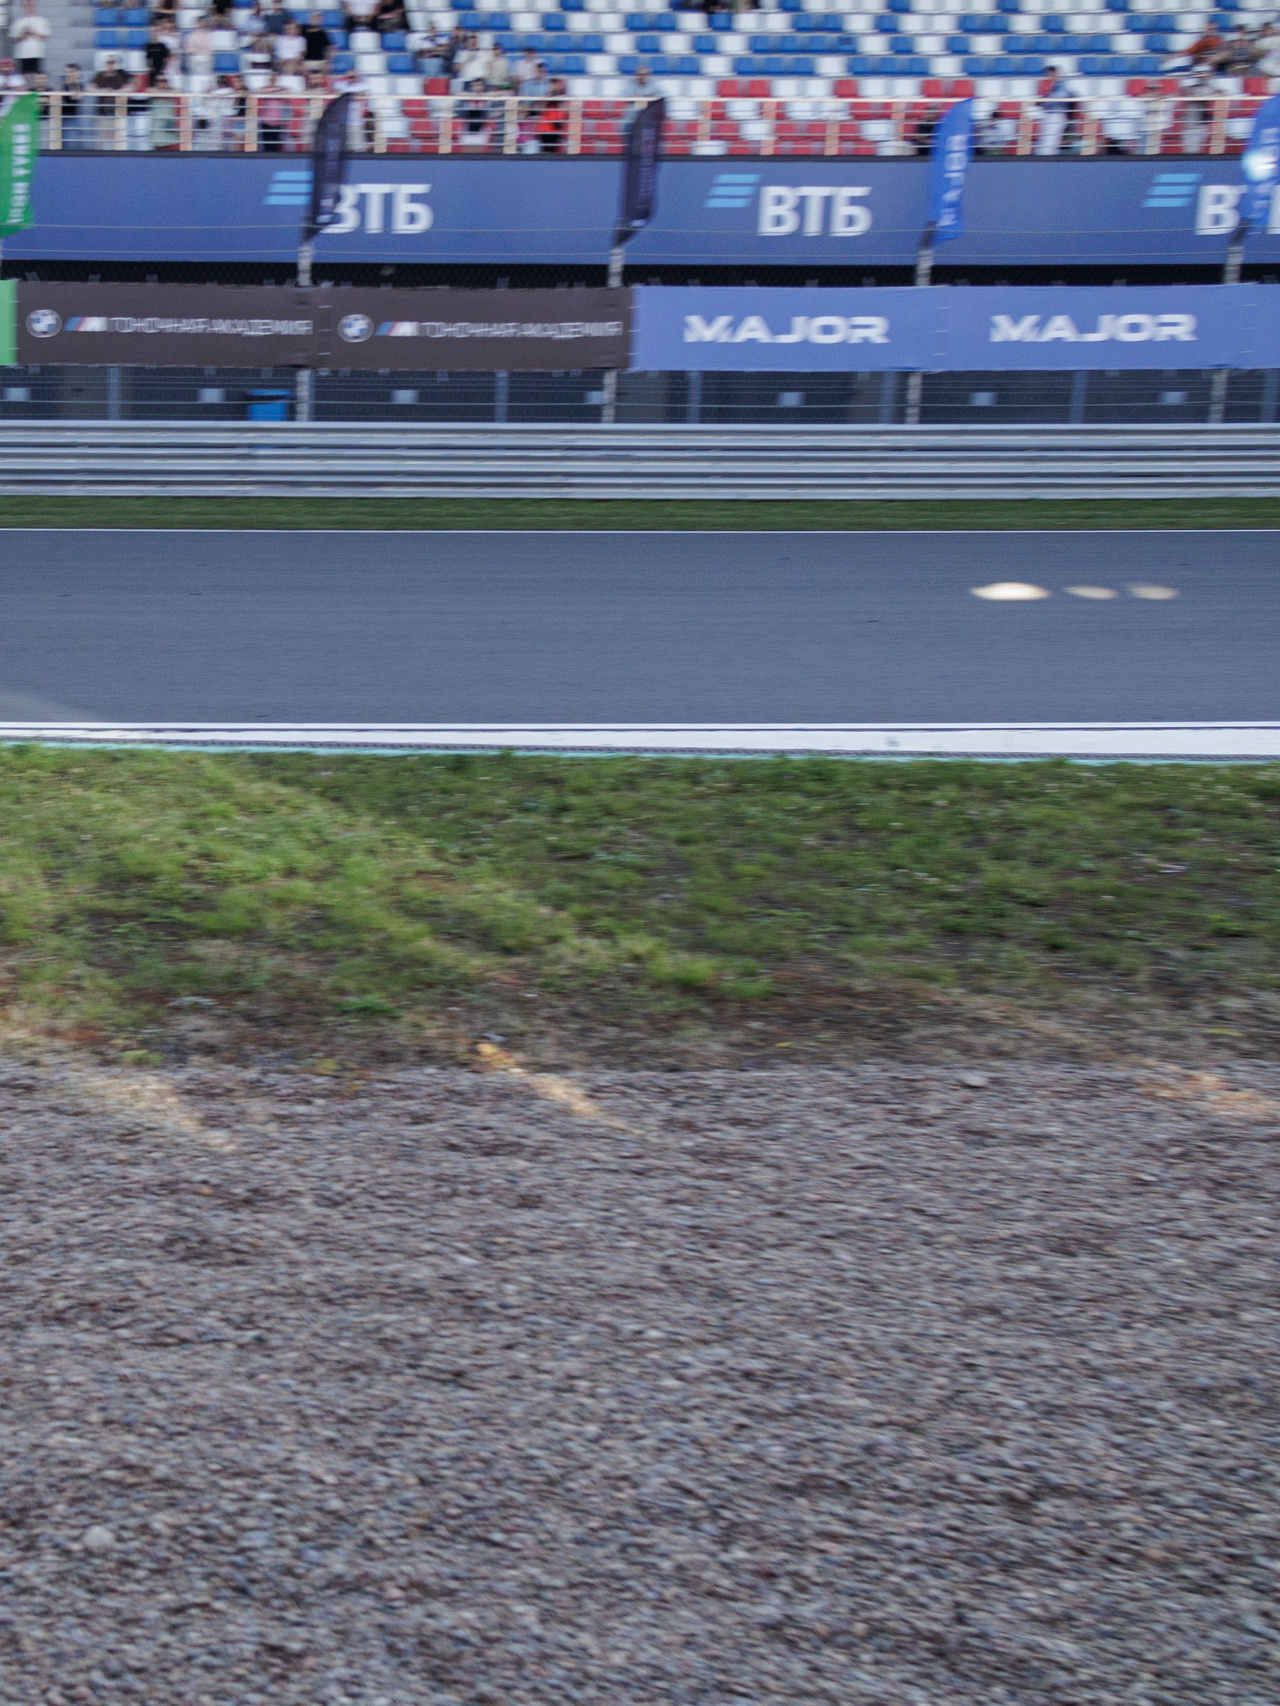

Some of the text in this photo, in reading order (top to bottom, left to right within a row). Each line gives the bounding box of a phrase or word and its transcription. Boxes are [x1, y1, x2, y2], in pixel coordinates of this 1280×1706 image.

[757, 186, 873, 237] ВТБ
[684, 315, 891, 343] MAJOR
[989, 313, 1198, 342] MAJOR
